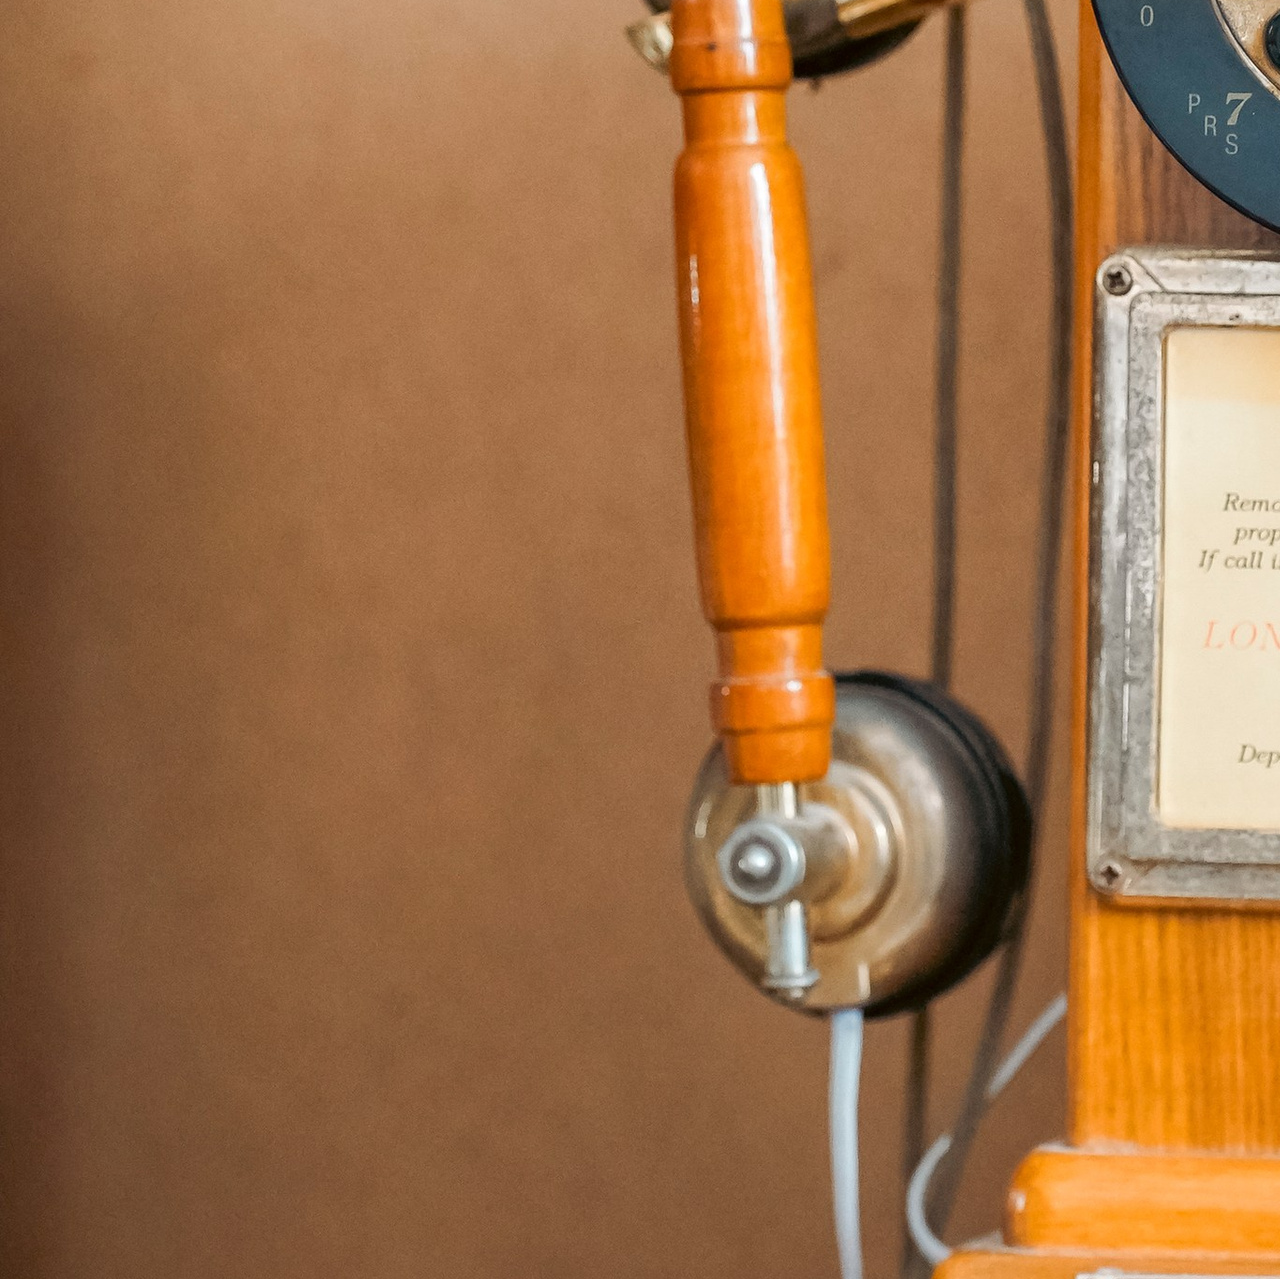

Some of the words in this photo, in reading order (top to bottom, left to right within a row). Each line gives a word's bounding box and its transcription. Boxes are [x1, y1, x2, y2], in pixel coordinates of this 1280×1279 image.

[1188, 93, 1239, 155] PRS
[1225, 92, 1253, 126] 7
[1198, 549, 1219, 571] If
[1224, 551, 1263, 570] call
